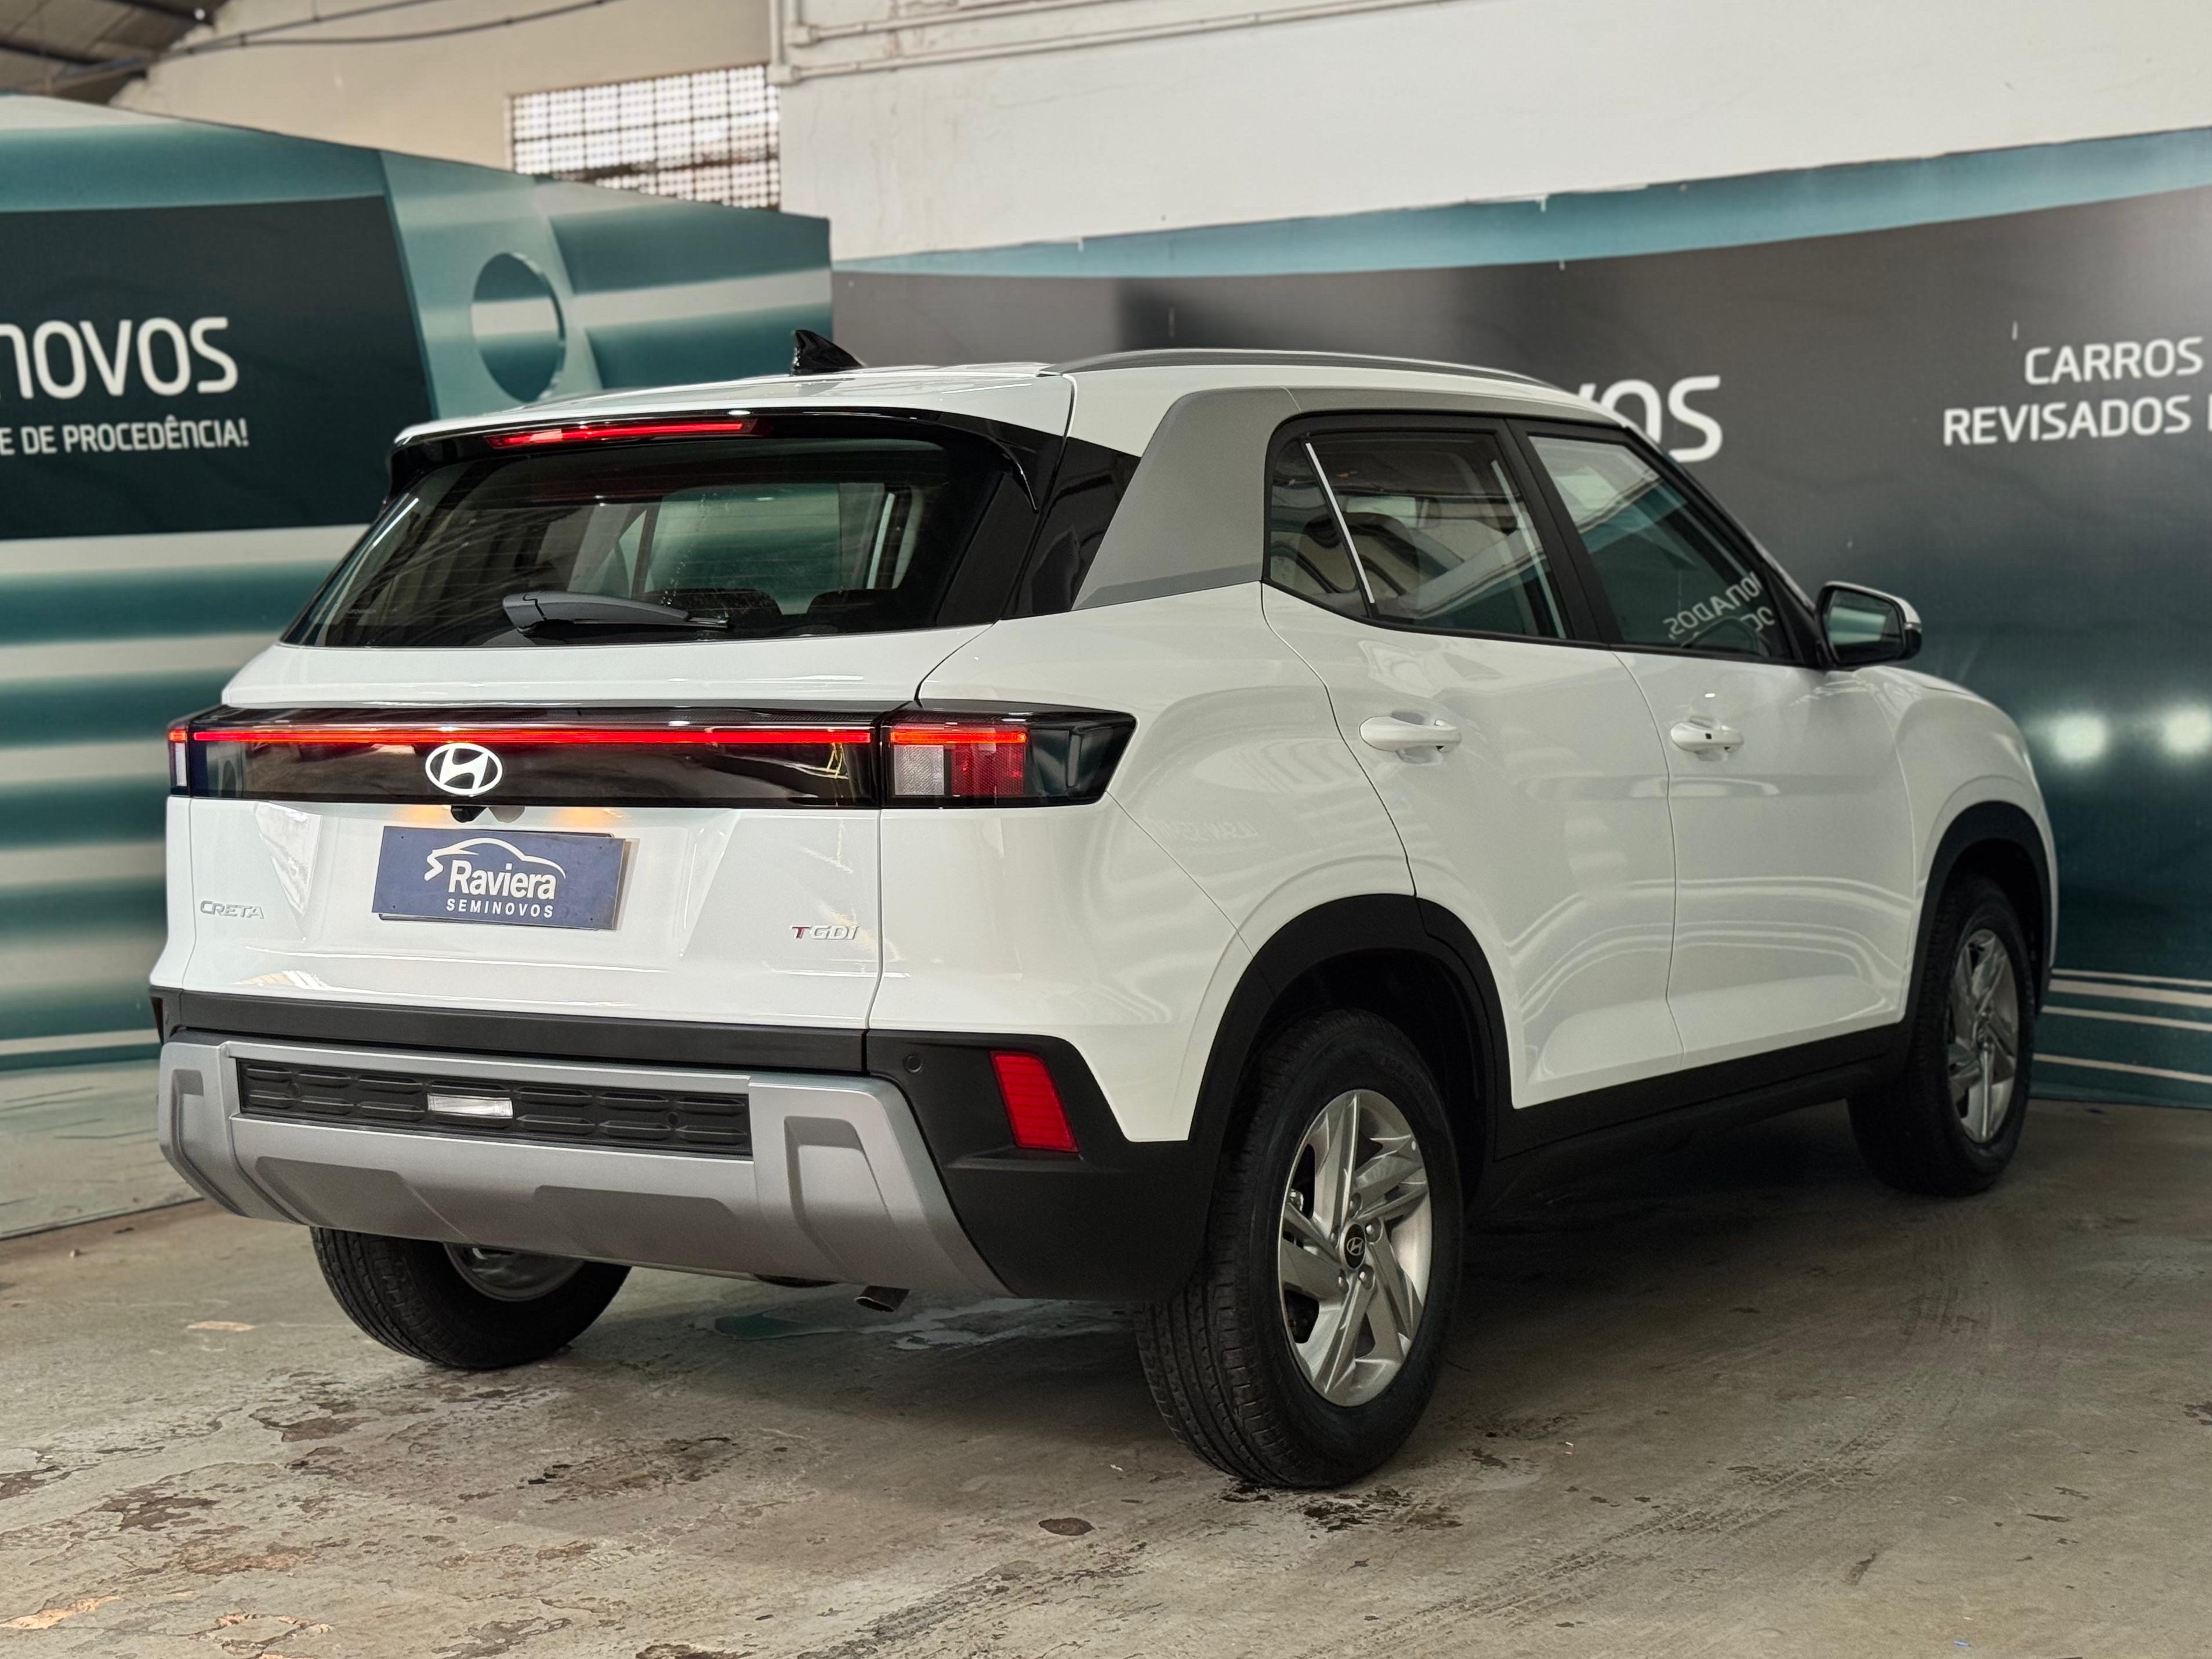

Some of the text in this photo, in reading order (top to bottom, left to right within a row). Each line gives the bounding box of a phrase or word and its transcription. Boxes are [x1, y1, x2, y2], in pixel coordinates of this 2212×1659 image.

[2025, 336, 2204, 385] CARROS
[20, 426, 57, 455] DE
[62, 414, 249, 453] PROCEDÊNCIA!
[1943, 394, 2192, 446] REVISADOS
[448, 859, 557, 900] Raviera
[200, 900, 264, 920] CRETA
[446, 898, 554, 919] SEMINOVOS
